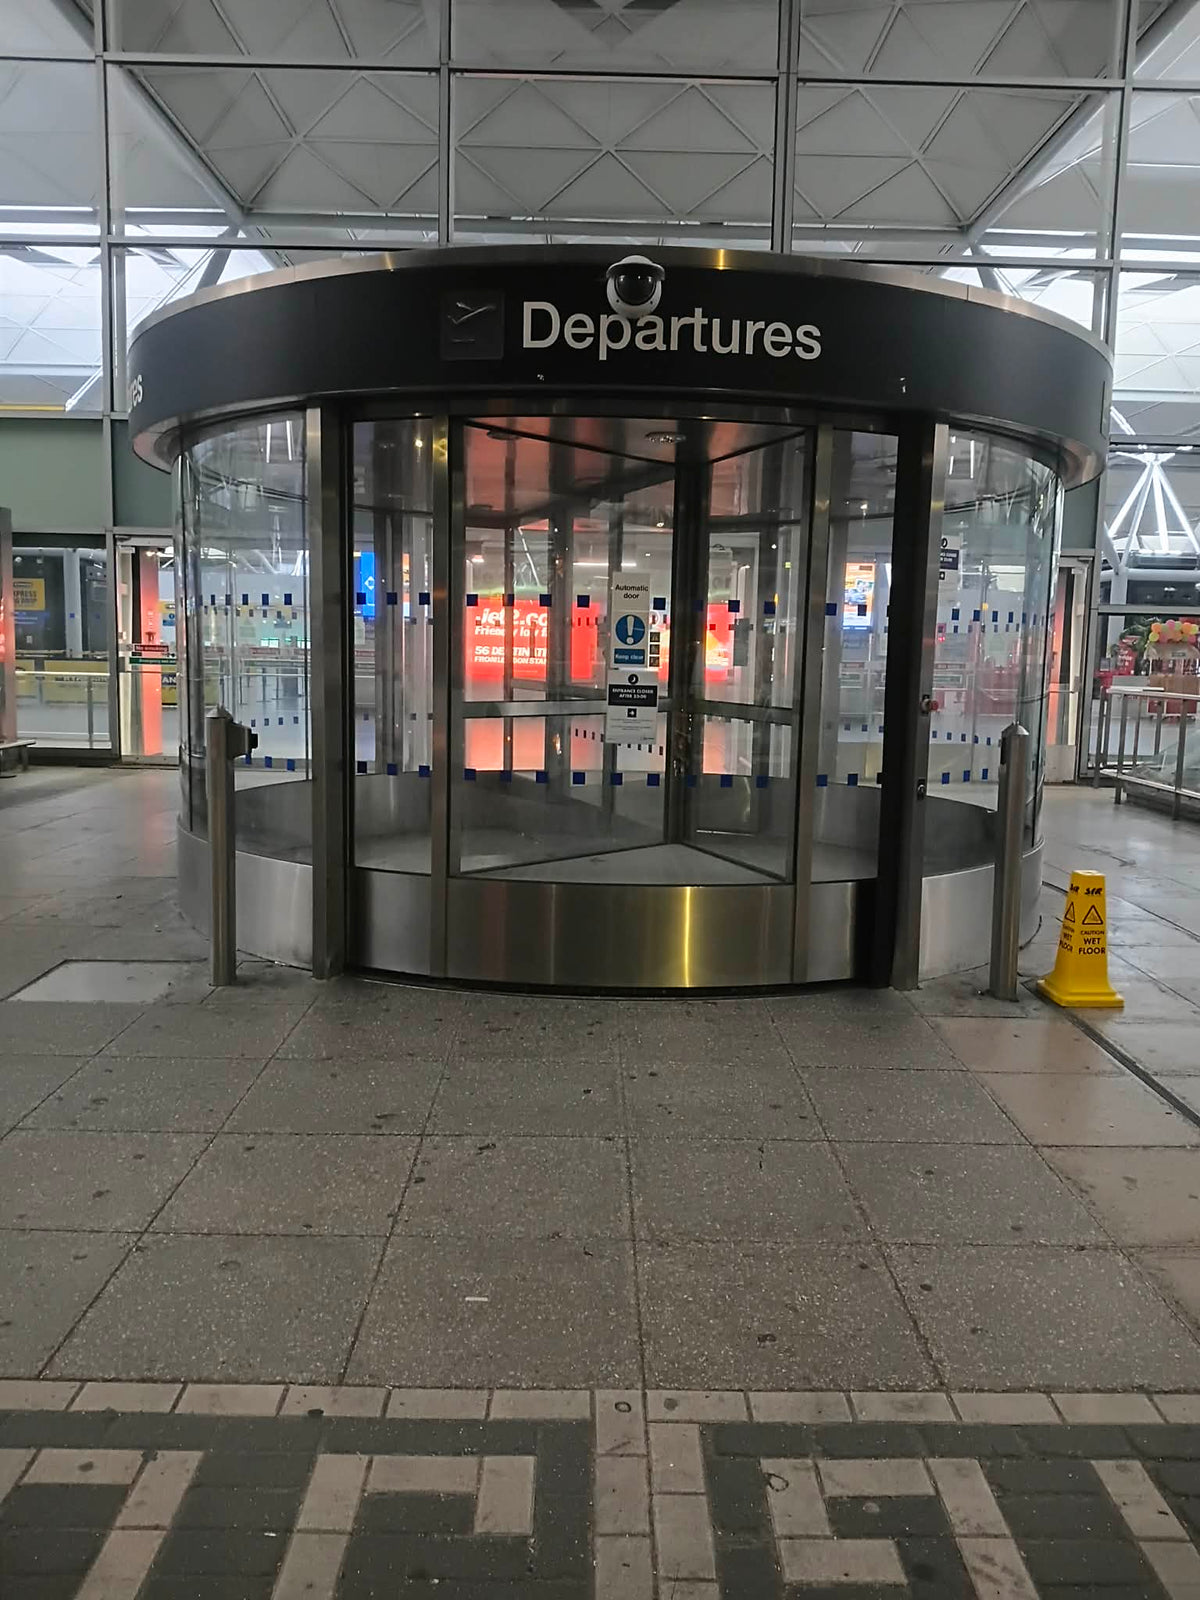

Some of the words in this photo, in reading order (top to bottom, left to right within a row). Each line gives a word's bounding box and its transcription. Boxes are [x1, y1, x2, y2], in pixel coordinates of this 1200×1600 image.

[522, 301, 822, 361] Departures
[615, 584, 649, 592] Automatic
[474, 645, 490, 655] 56
[1083, 937, 1101, 945] WET
[1078, 947, 1106, 955] FLOOR
